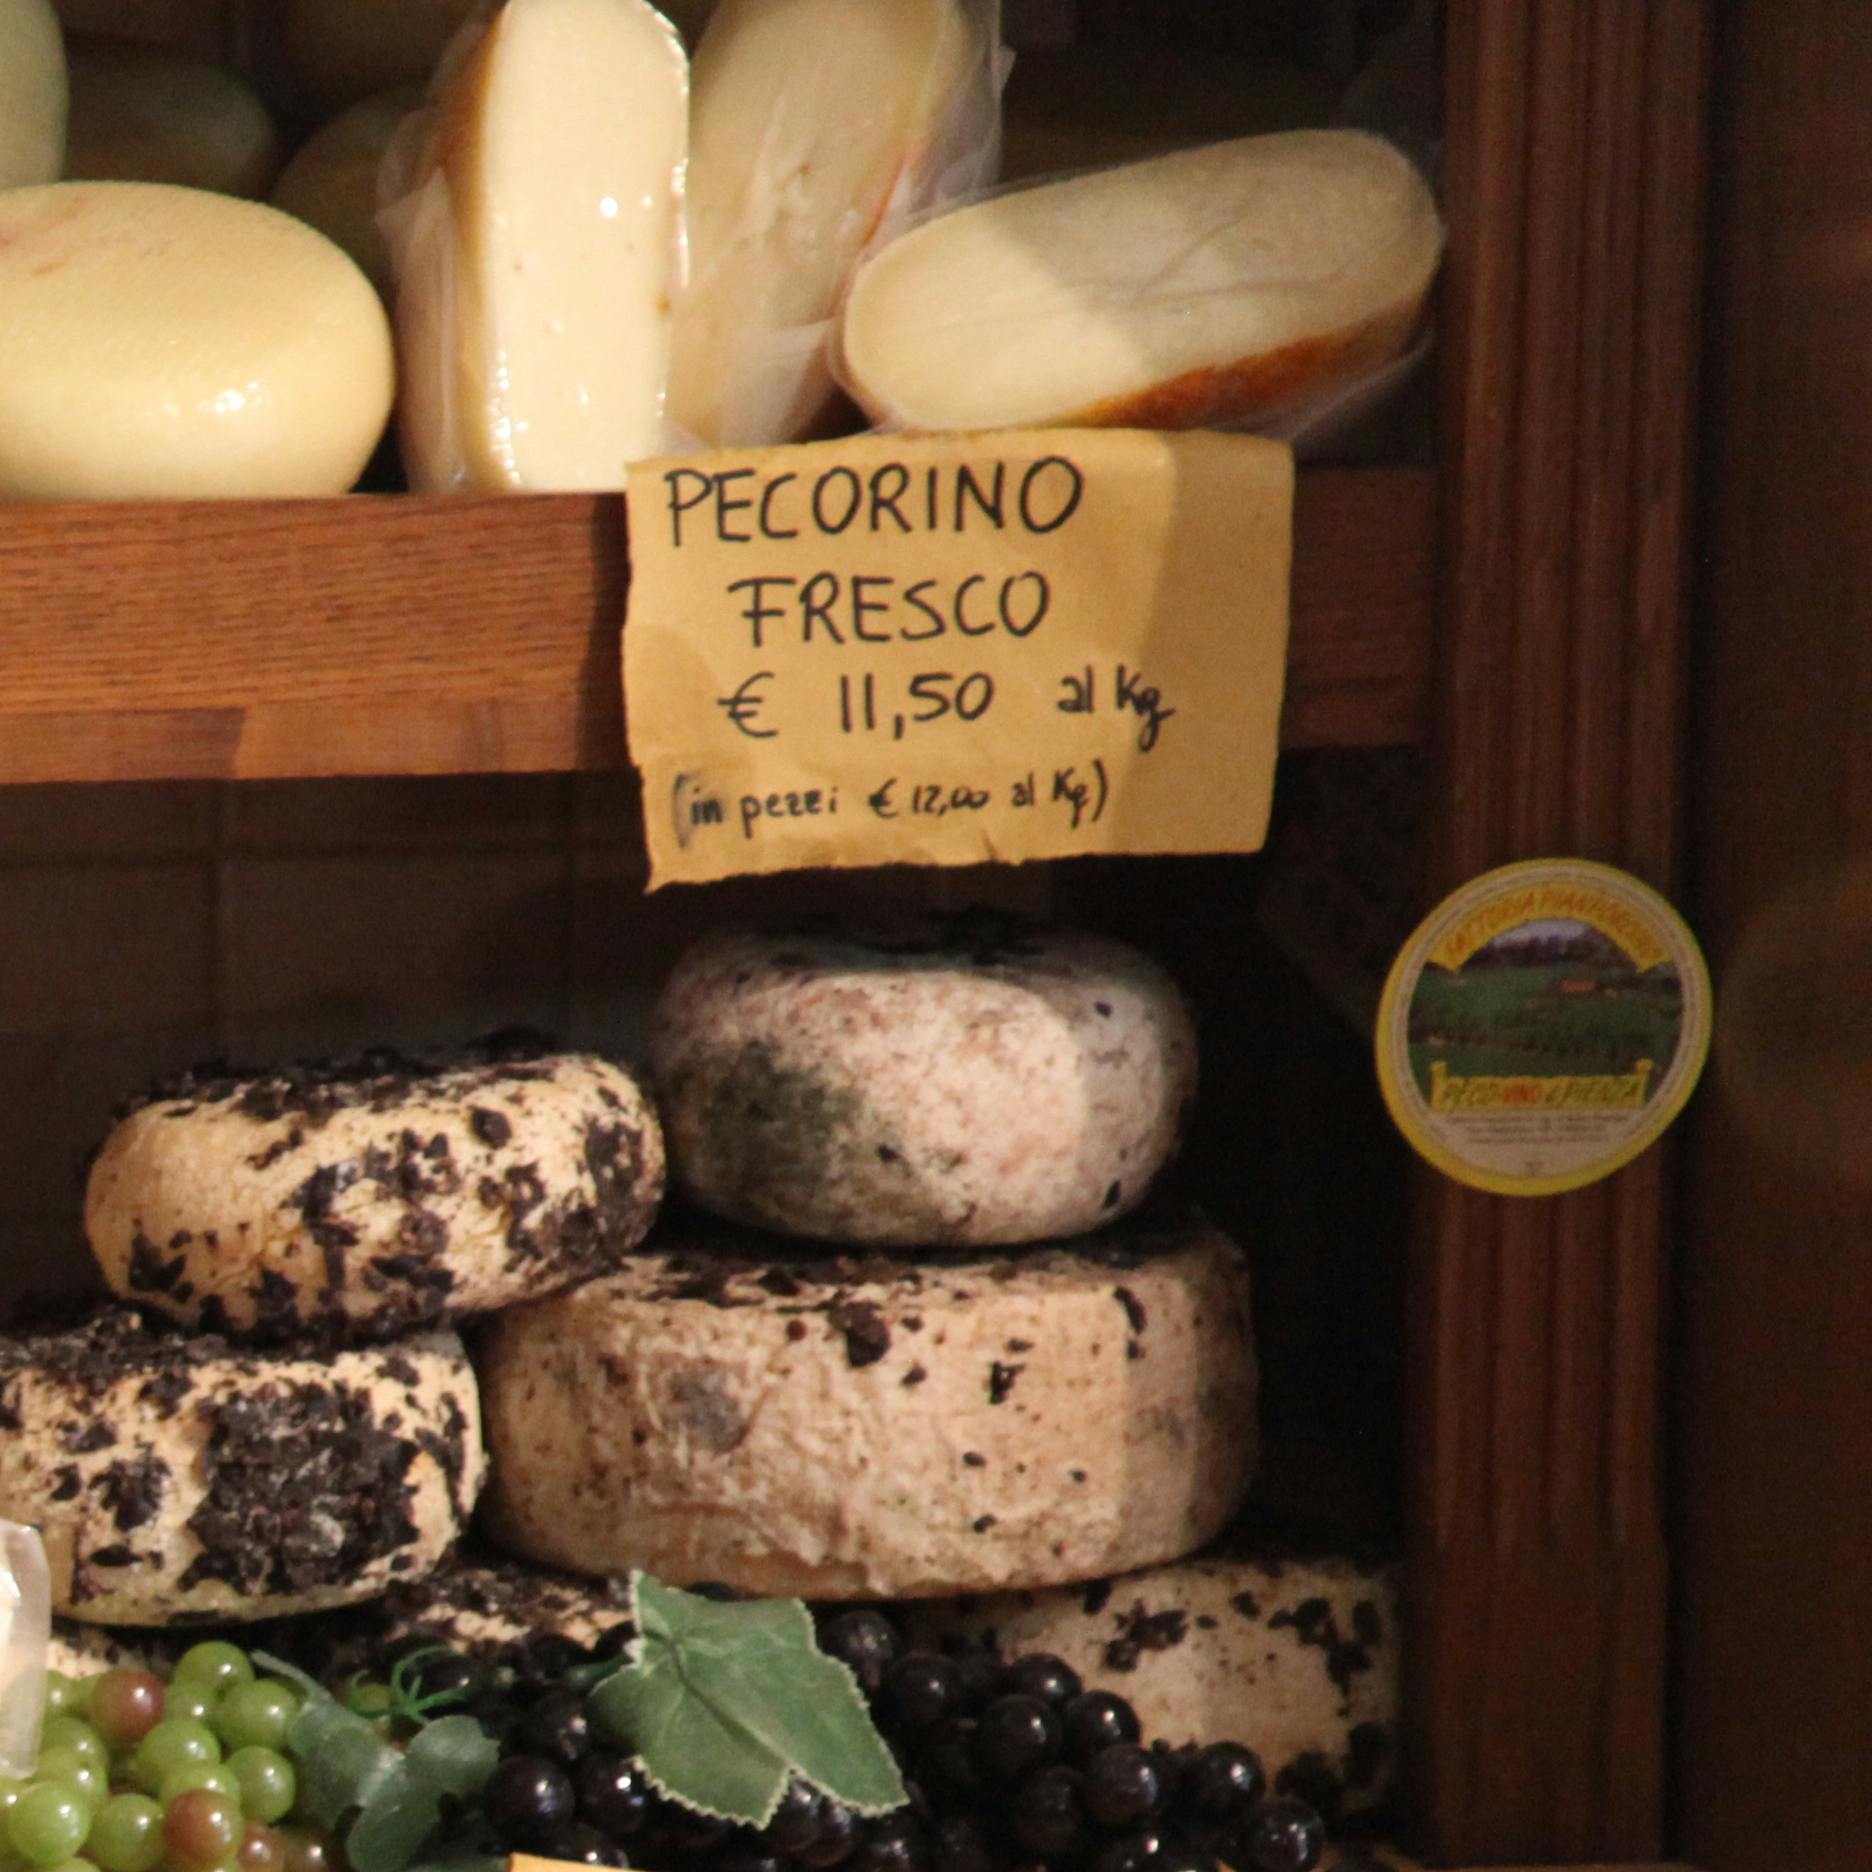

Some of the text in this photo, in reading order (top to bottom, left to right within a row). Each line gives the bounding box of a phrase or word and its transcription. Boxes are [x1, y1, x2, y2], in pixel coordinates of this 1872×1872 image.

[662, 455, 1084, 547] PECORINO
[727, 571, 1051, 647] FRESCO
[717, 671, 778, 738] €
[840, 671, 995, 741] 11,50
[1057, 665, 1095, 715] al
[740, 785, 841, 839] pezzi
[868, 777, 899, 818] €
